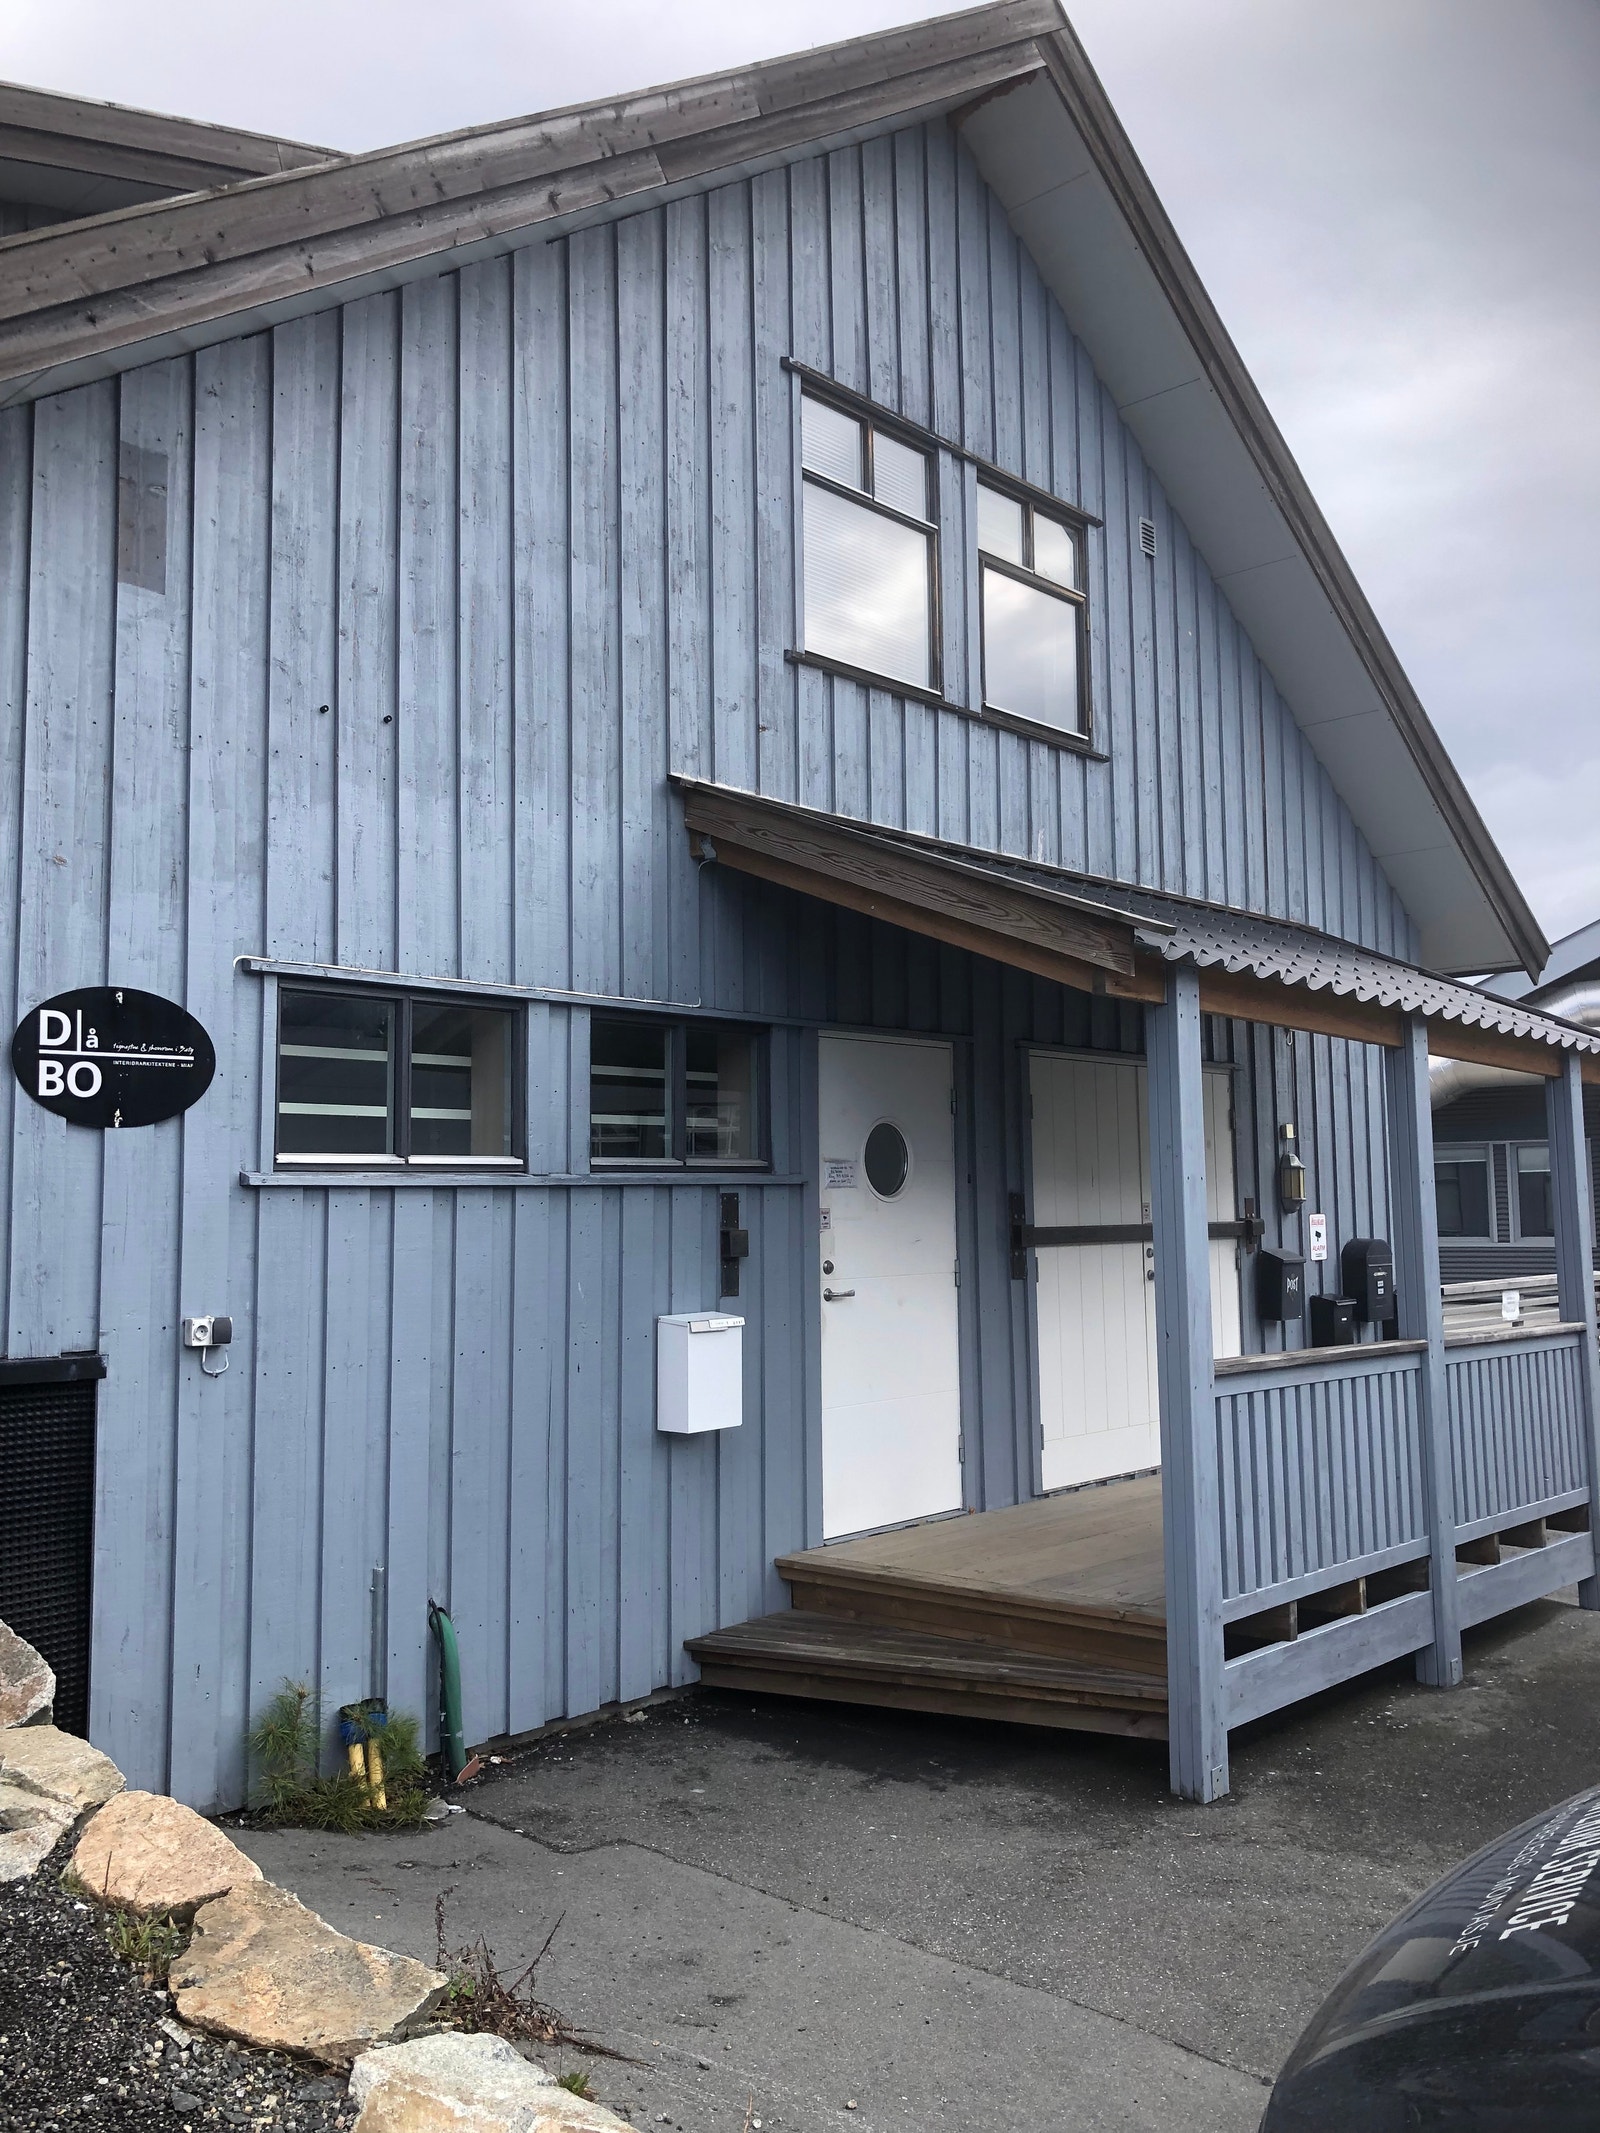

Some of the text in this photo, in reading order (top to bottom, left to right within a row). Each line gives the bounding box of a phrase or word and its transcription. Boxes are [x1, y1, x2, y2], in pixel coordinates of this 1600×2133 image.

[140, 1043, 147, 1052] &
[38, 1059, 103, 1098] BO
[1286, 1276, 1299, 1293] POST
[1449, 1874, 1520, 1956] MONTASJE
[1499, 1850, 1600, 1941] SERVICE
